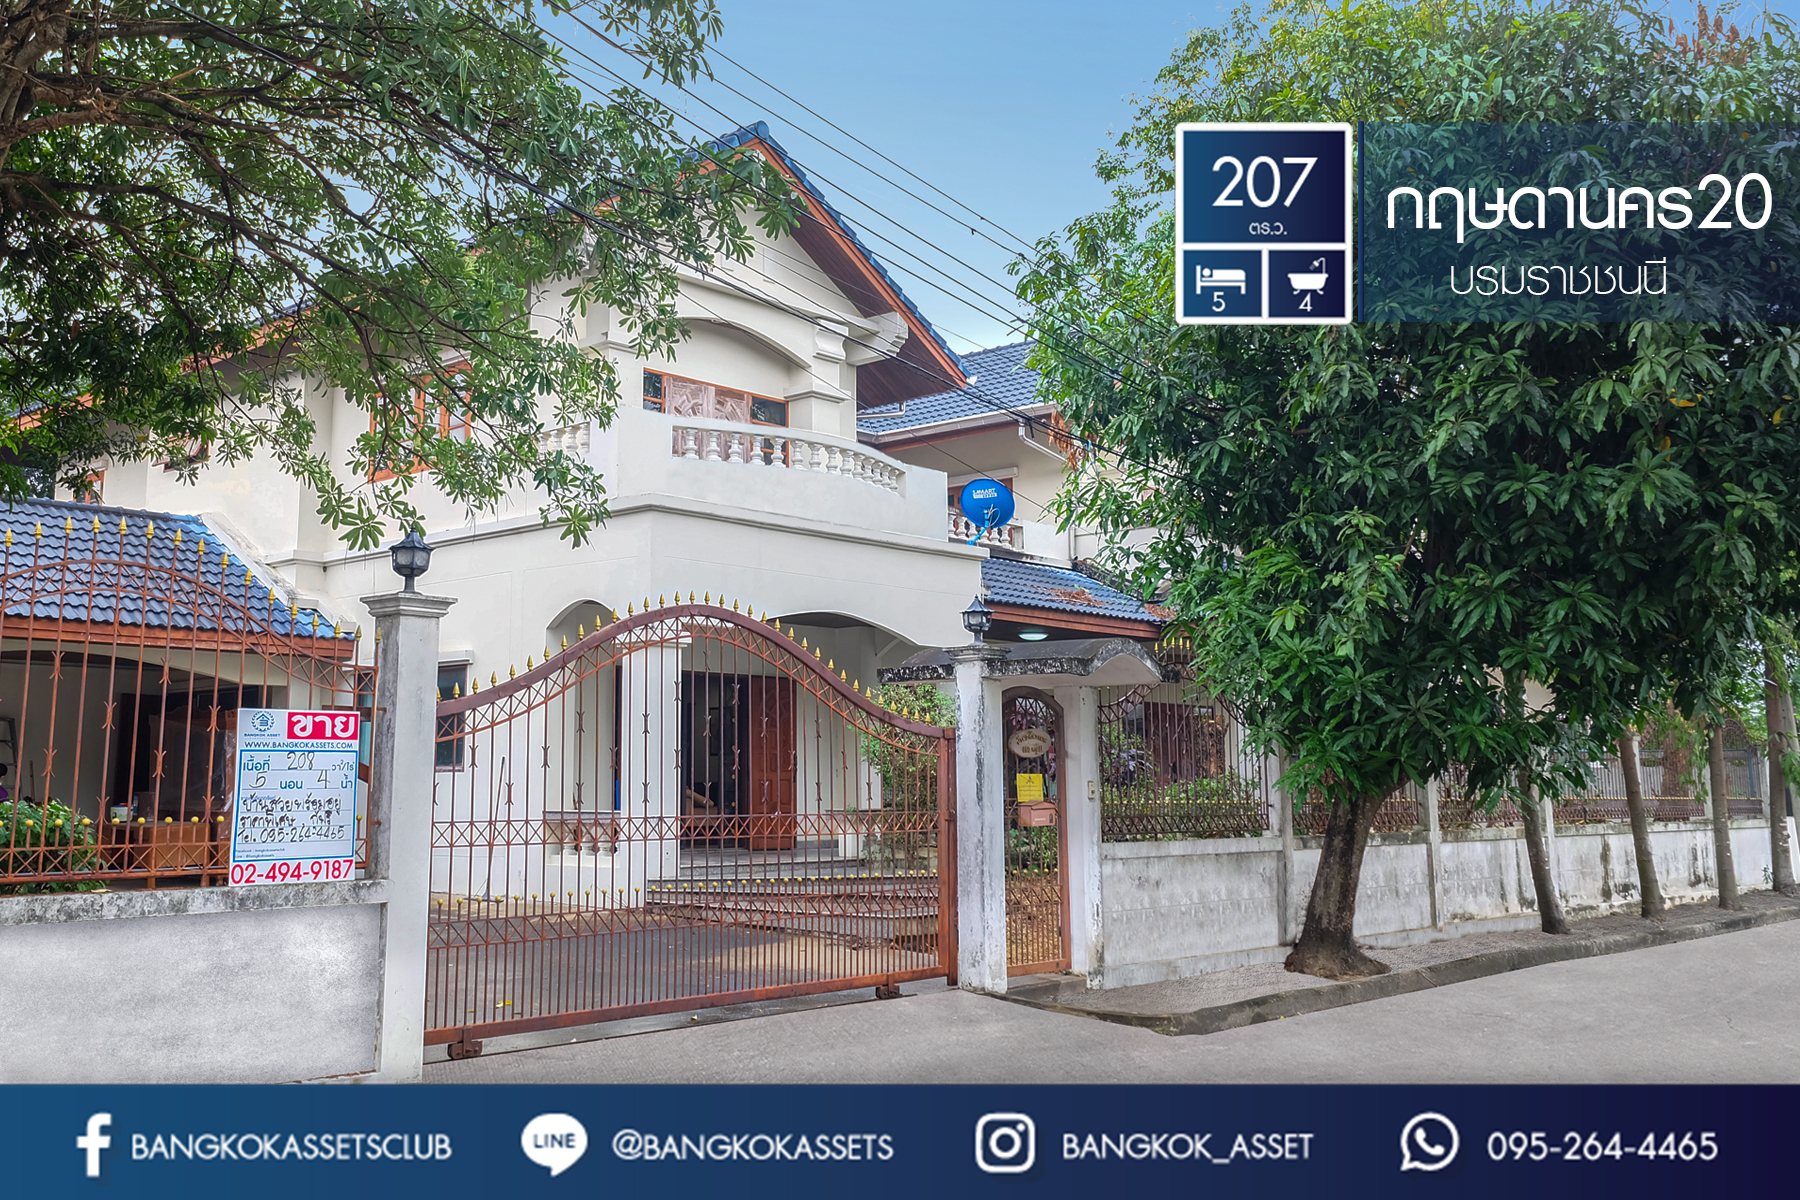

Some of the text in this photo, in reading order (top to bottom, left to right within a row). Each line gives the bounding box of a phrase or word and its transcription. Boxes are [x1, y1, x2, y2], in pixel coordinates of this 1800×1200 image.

[291, 715, 355, 738] ขาย
[244, 741, 354, 749] WWW.BANGKOKASSETS.COM
[243, 755, 271, 771] เนื้อที่
[286, 751, 315, 770] 208
[249, 771, 268, 788] 5
[280, 780, 303, 789] นอน
[317, 770, 331, 789] 4
[230, 859, 354, 884] 02-494-9187
